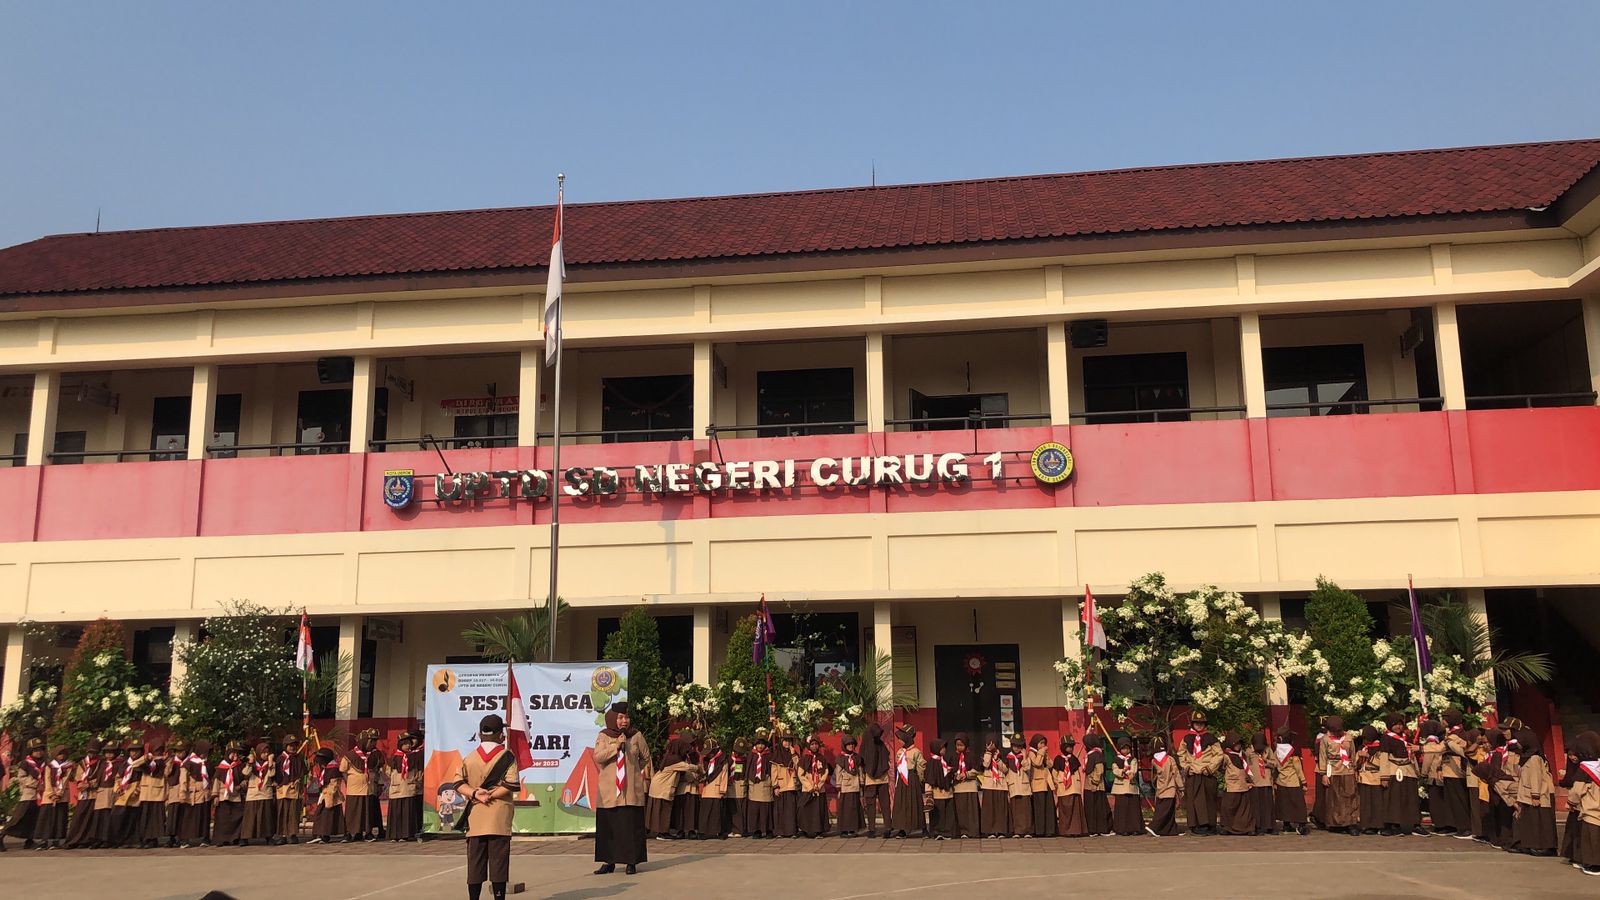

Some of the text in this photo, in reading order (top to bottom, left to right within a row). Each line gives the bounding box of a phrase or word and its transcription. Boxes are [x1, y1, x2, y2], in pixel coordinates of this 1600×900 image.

[435, 451, 1002, 500] UPTD SD NEGERI CURUG 1
[459, 694, 593, 711] PEST SIAGA
